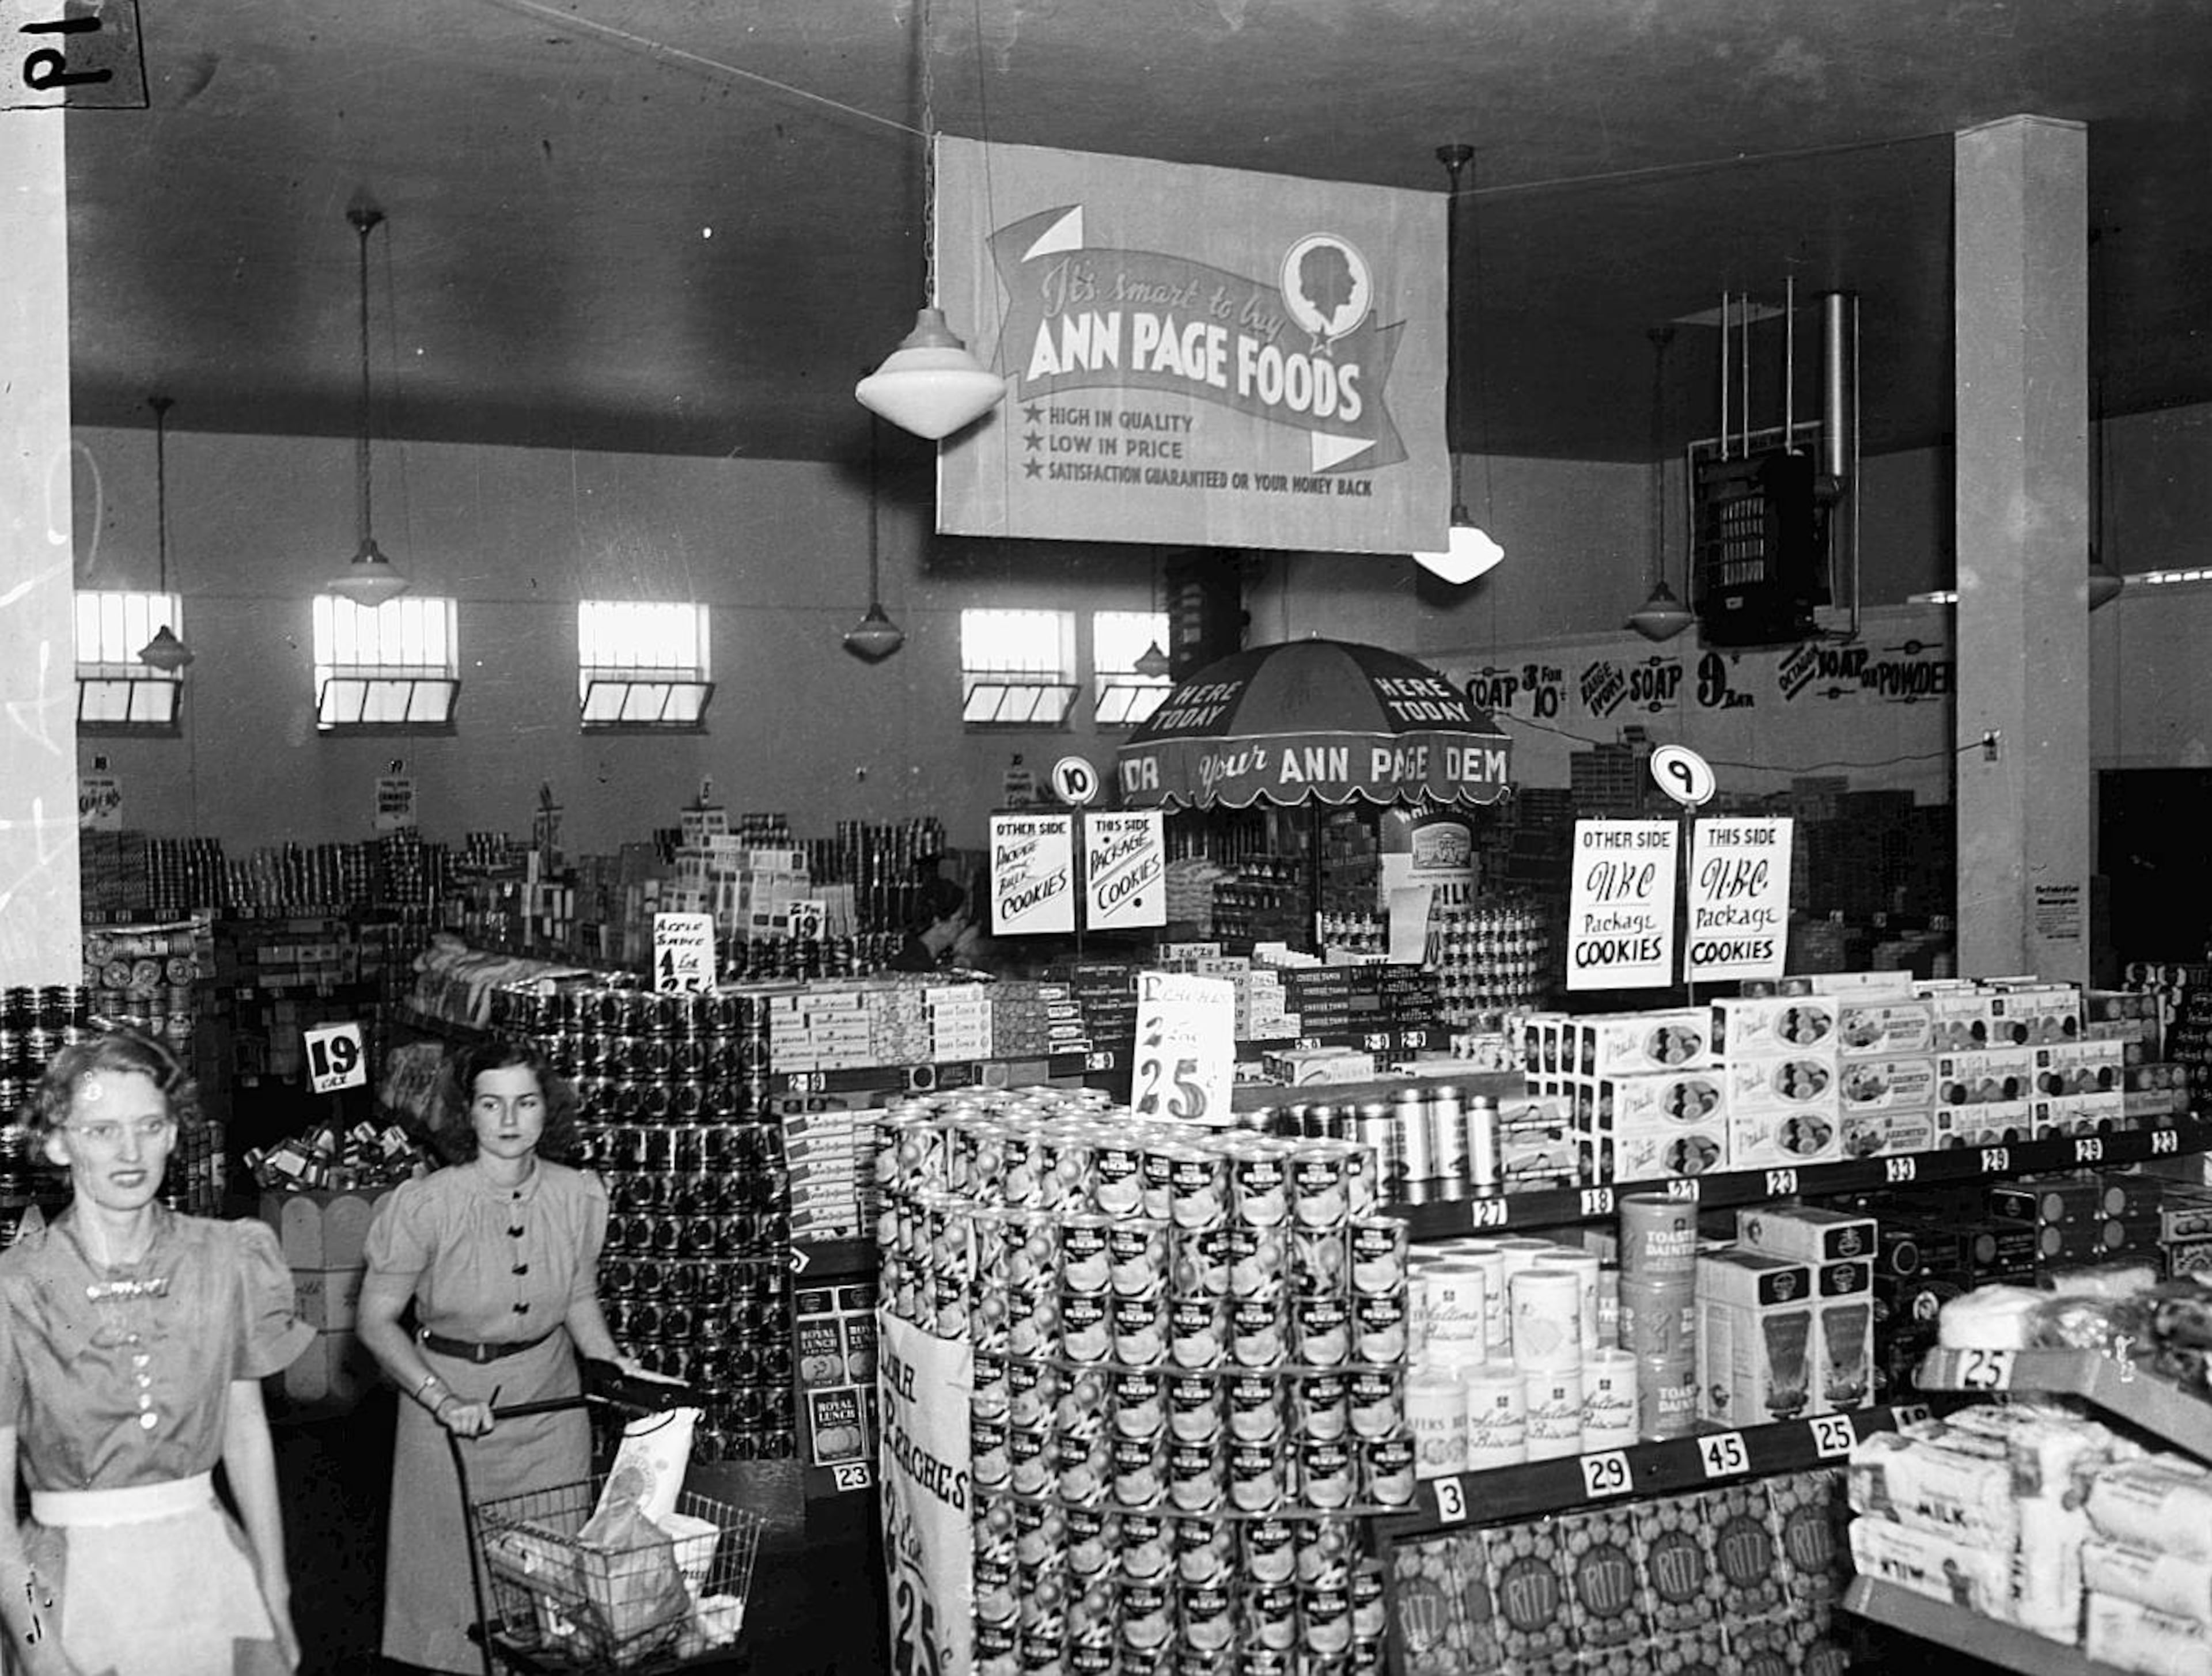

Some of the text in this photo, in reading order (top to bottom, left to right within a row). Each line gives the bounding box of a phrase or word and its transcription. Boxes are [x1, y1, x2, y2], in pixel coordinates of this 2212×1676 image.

[1041, 256, 1286, 343] It's smart to buy
[1027, 310, 1362, 422] ANN PAGE FOODS
[1048, 407, 1193, 433] HIGH IN QUALITY
[1049, 435, 1183, 459] LOW IN PRICE
[1048, 462, 1373, 498] SATISFACTION GUARANTEED OR YOUR MONEY BACK
[1522, 663, 1539, 691] 3
[1817, 648, 1869, 680] SOAP
[1174, 680, 1243, 703] HERE
[1374, 677, 1452, 698] HERE
[1630, 665, 1683, 702] SOAP
[1152, 705, 1226, 731] TODAY
[1389, 700, 1471, 723] TODAY
[1278, 747, 1350, 784] ANN
[1370, 746, 1428, 783] PAGE
[1446, 749, 1507, 783] DEM
[1668, 760, 1693, 794] 9
[1063, 768, 1088, 795] 10
[997, 821, 1066, 836] OTHER SIDE
[1096, 818, 1150, 836] THIS SIDE
[1583, 831, 1671, 848] OTHER SIDE
[1708, 828, 1777, 845] THIS SIDE
[1002, 868, 1067, 920] COOKIES
[1099, 853, 1161, 909] COOKIES
[1585, 911, 1657, 934] Package
[1696, 904, 1782, 932] Package
[1575, 936, 1662, 968] COOKIES
[1691, 939, 1774, 966] COOKIES
[312, 1035, 359, 1076] 19
[1136, 1057, 1207, 1119] 25
[1480, 1201, 1499, 1227] 27
[1588, 1192, 1608, 1213] 18
[801, 1327, 835, 1340] ROYAL
[801, 1337, 837, 1350] LUNCH
[1963, 1350, 2002, 1389] 25
[817, 1398, 855, 1412] ROYAL
[819, 1409, 856, 1423] LUNCH
[884, 1387, 969, 1511] PEACHES
[1817, 1423, 1850, 1450] 25
[1707, 1442, 1743, 1470] 45
[839, 1466, 867, 1487] 23
[1589, 1459, 1626, 1490] 29
[1442, 1484, 1462, 1515] 3
[1655, 1545, 1699, 1592] RITZ
[1725, 1532, 1766, 1578] RITZ
[1508, 1573, 1551, 1624] RITZ
[1585, 1561, 1628, 1609] RITZ
